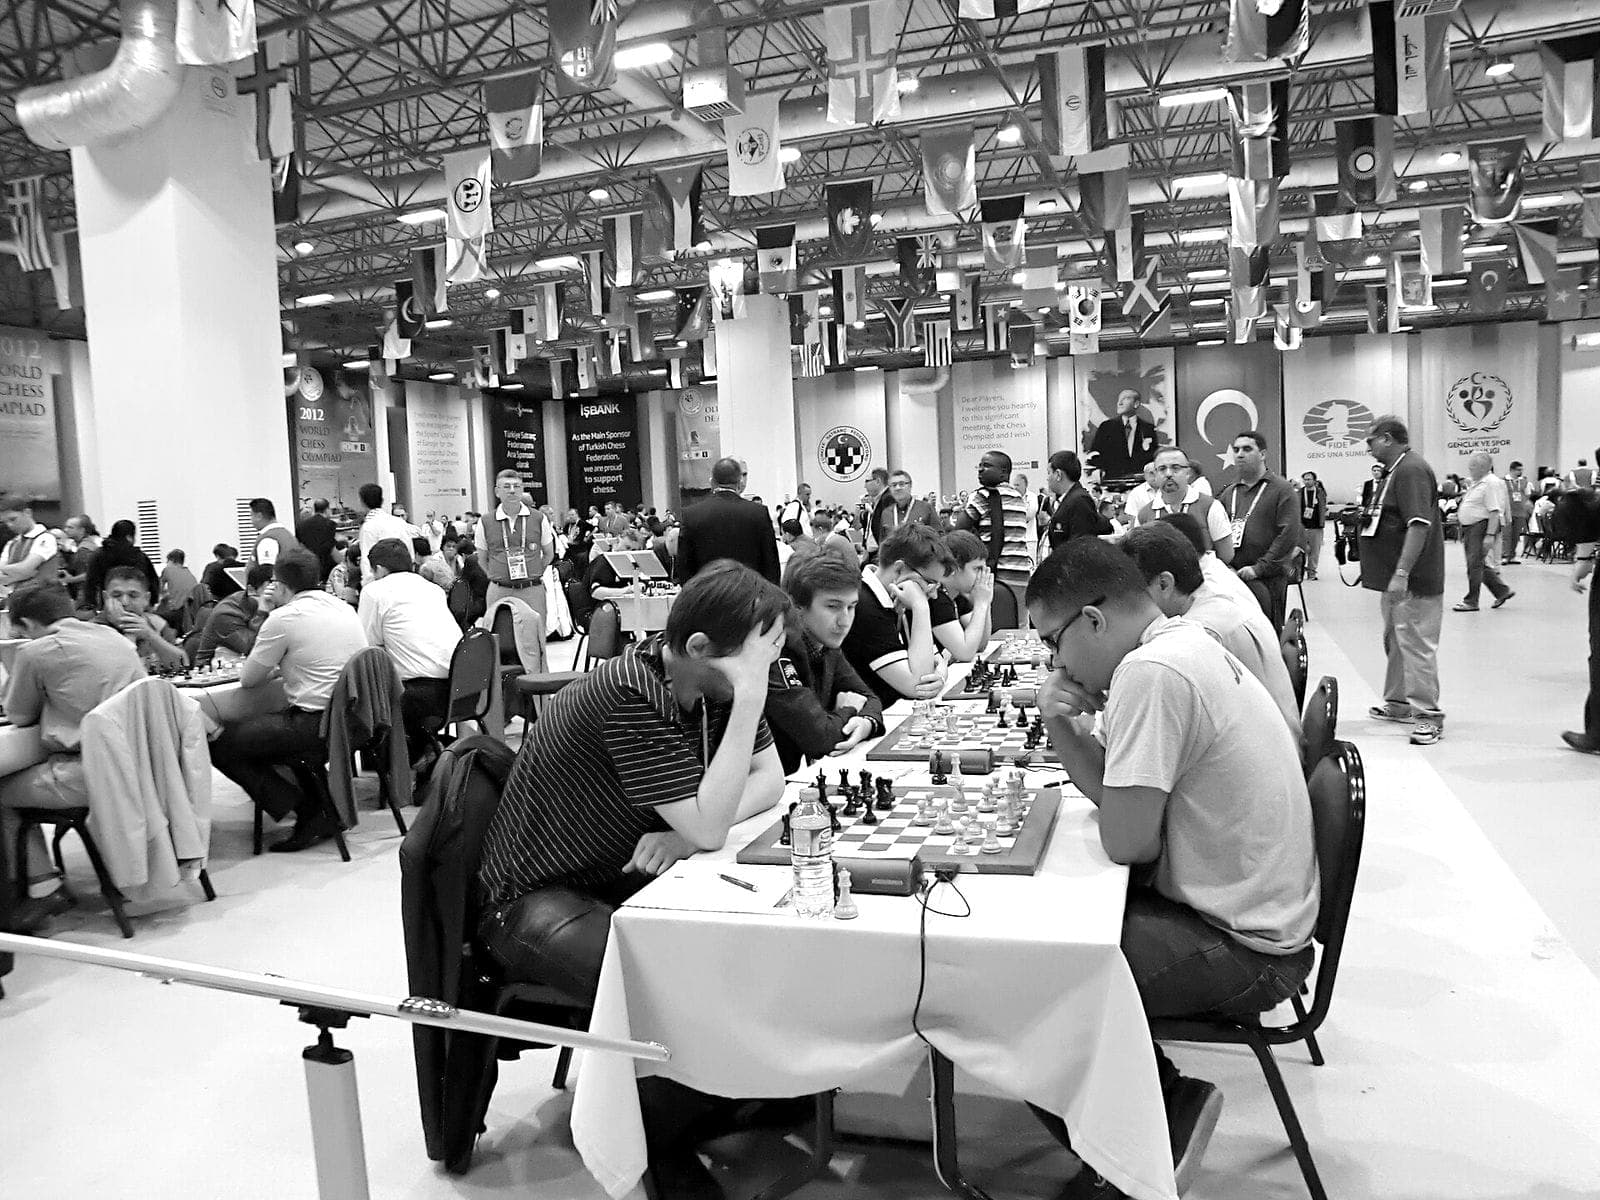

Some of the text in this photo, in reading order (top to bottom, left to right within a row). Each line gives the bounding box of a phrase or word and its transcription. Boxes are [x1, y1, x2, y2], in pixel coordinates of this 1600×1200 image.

[0, 337, 42, 359] 012
[0, 364, 42, 380] ORLD
[299, 407, 325, 421] 2012
[572, 431, 631, 441] As the Main Sponsor
[578, 442, 626, 451] of Turkish Chess
[1328, 441, 1348, 449] FIDE
[1491, 439, 1511, 447] SPOR
[604, 463, 623, 472] proud
[584, 474, 624, 484] to support
